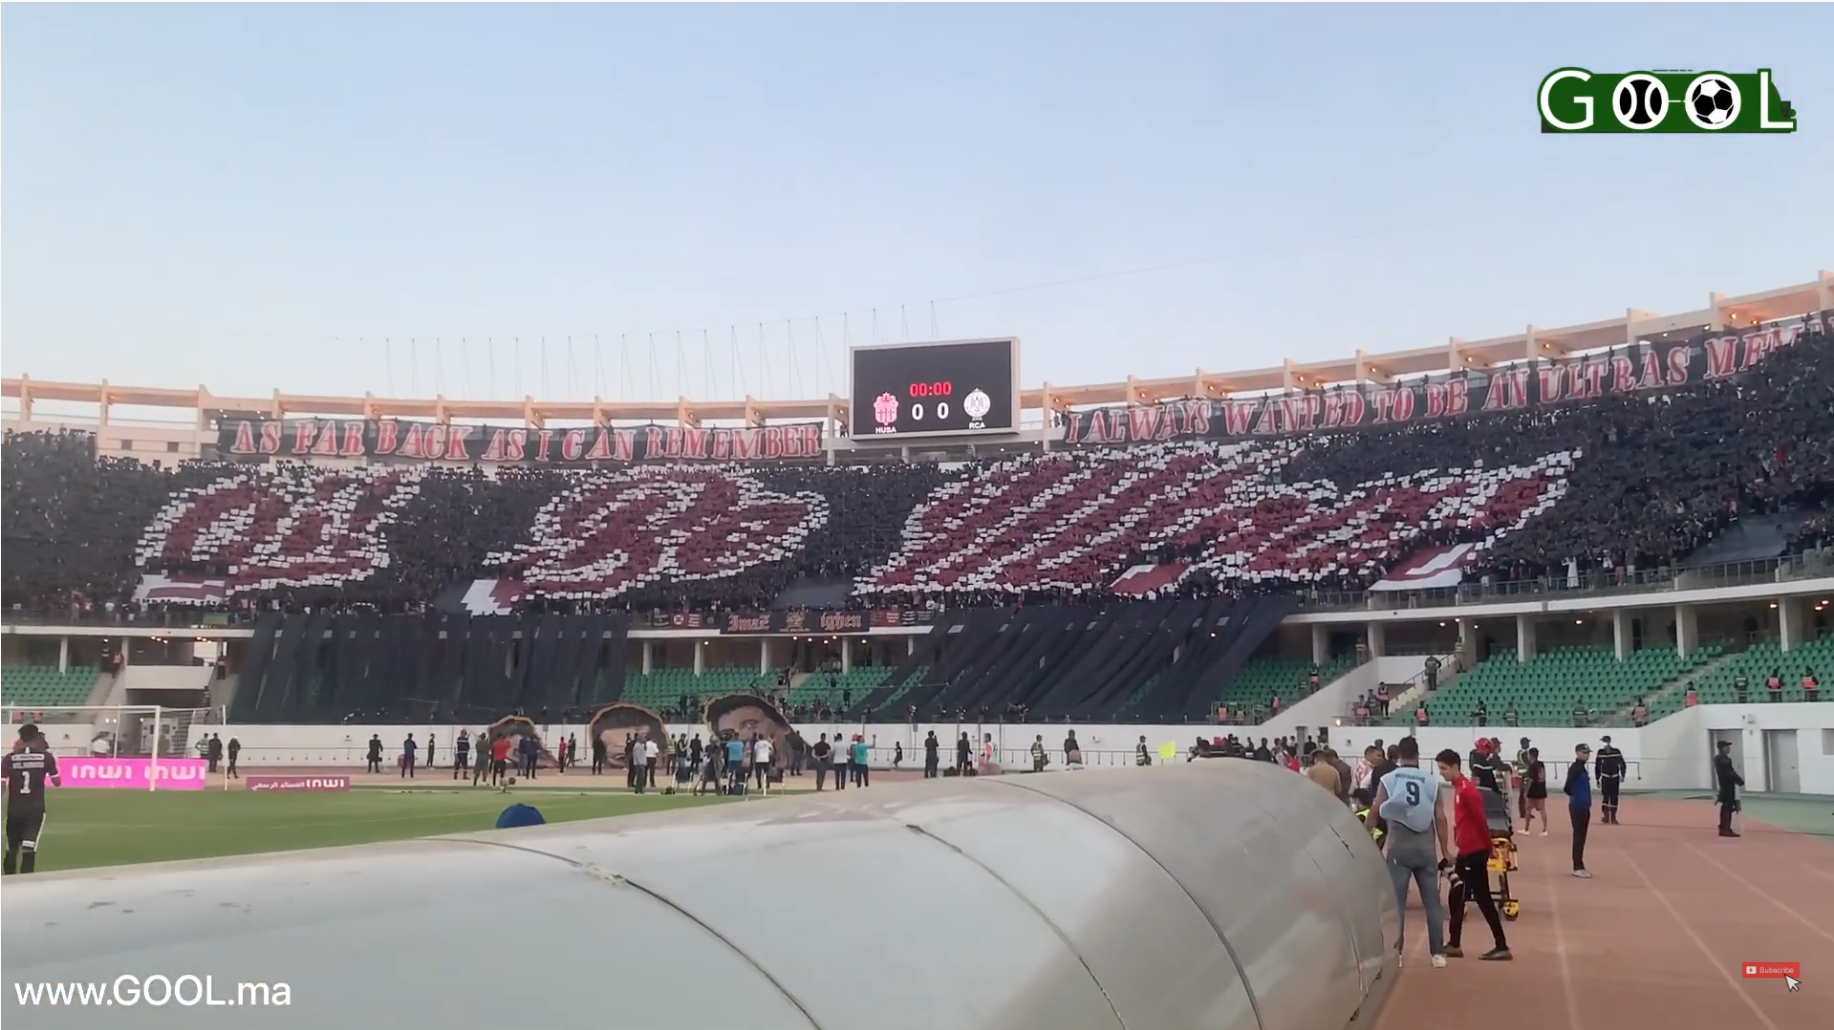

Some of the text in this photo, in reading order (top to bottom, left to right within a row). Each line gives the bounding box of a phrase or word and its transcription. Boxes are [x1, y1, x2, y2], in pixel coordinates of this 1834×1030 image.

[910, 382, 952, 397] 00:00
[1065, 411, 1082, 443] I
[1081, 397, 1213, 444] ALWAYS
[1221, 389, 1364, 436] WANTED
[1372, 386, 1414, 423] TO
[1423, 376, 1468, 418] BE
[1481, 367, 1530, 413] AN
[1536, 346, 1692, 403] ULTRAS
[911, 402, 949, 420] 0 0
[230, 418, 823, 462] AS FAR BACK AS I CAN REMEMBER
[875, 426, 897, 434] HUSA
[71, 765, 132, 779] inwi
[20, 771, 31, 794] 1
[1406, 781, 1420, 806] 9
